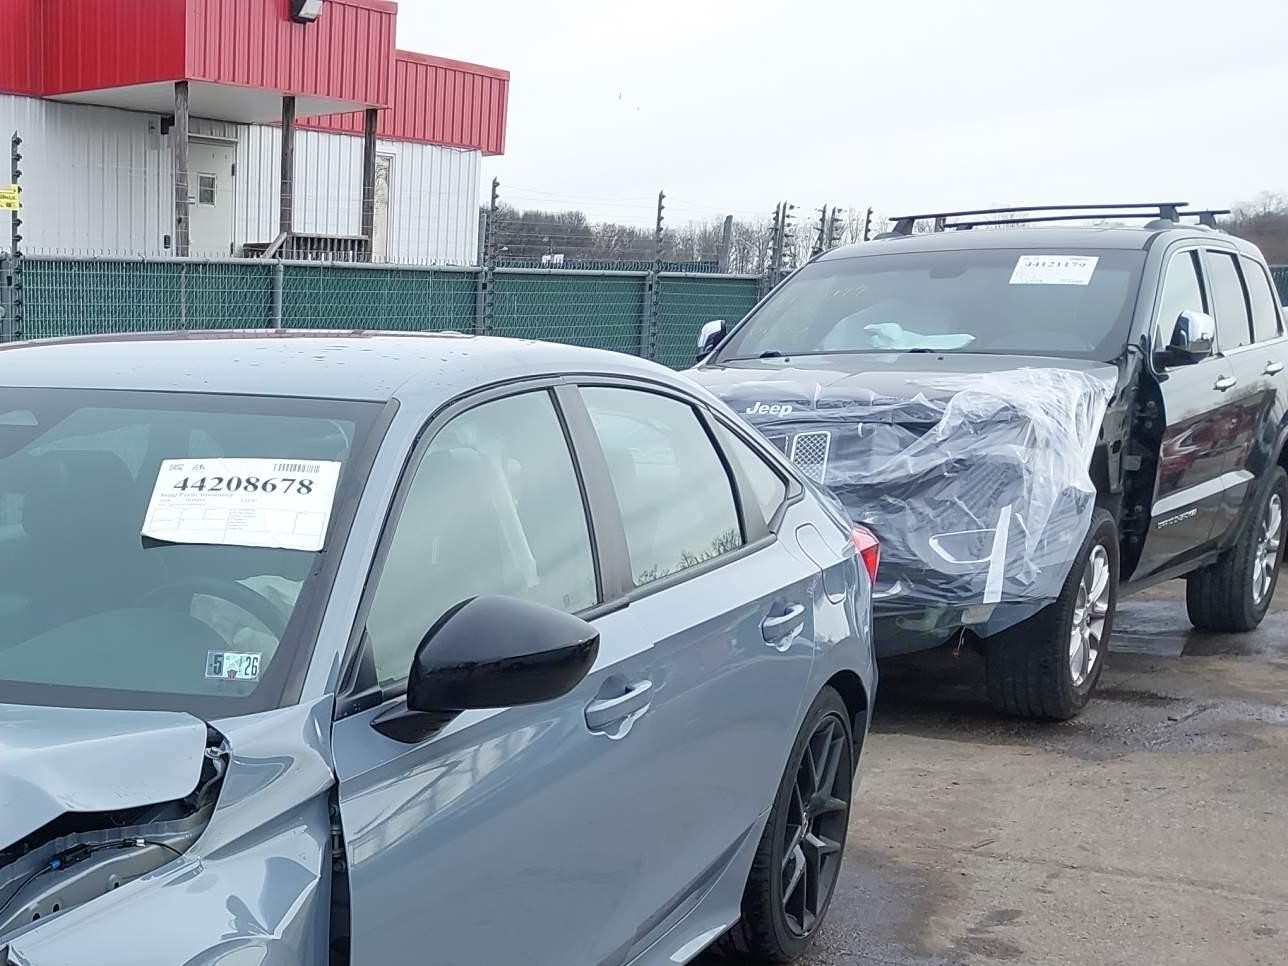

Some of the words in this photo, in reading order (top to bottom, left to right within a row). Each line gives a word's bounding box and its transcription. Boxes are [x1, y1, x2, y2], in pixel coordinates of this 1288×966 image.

[745, 401, 793, 418] Jeep
[173, 476, 315, 495] 44208678
[244, 656, 259, 676] 26
